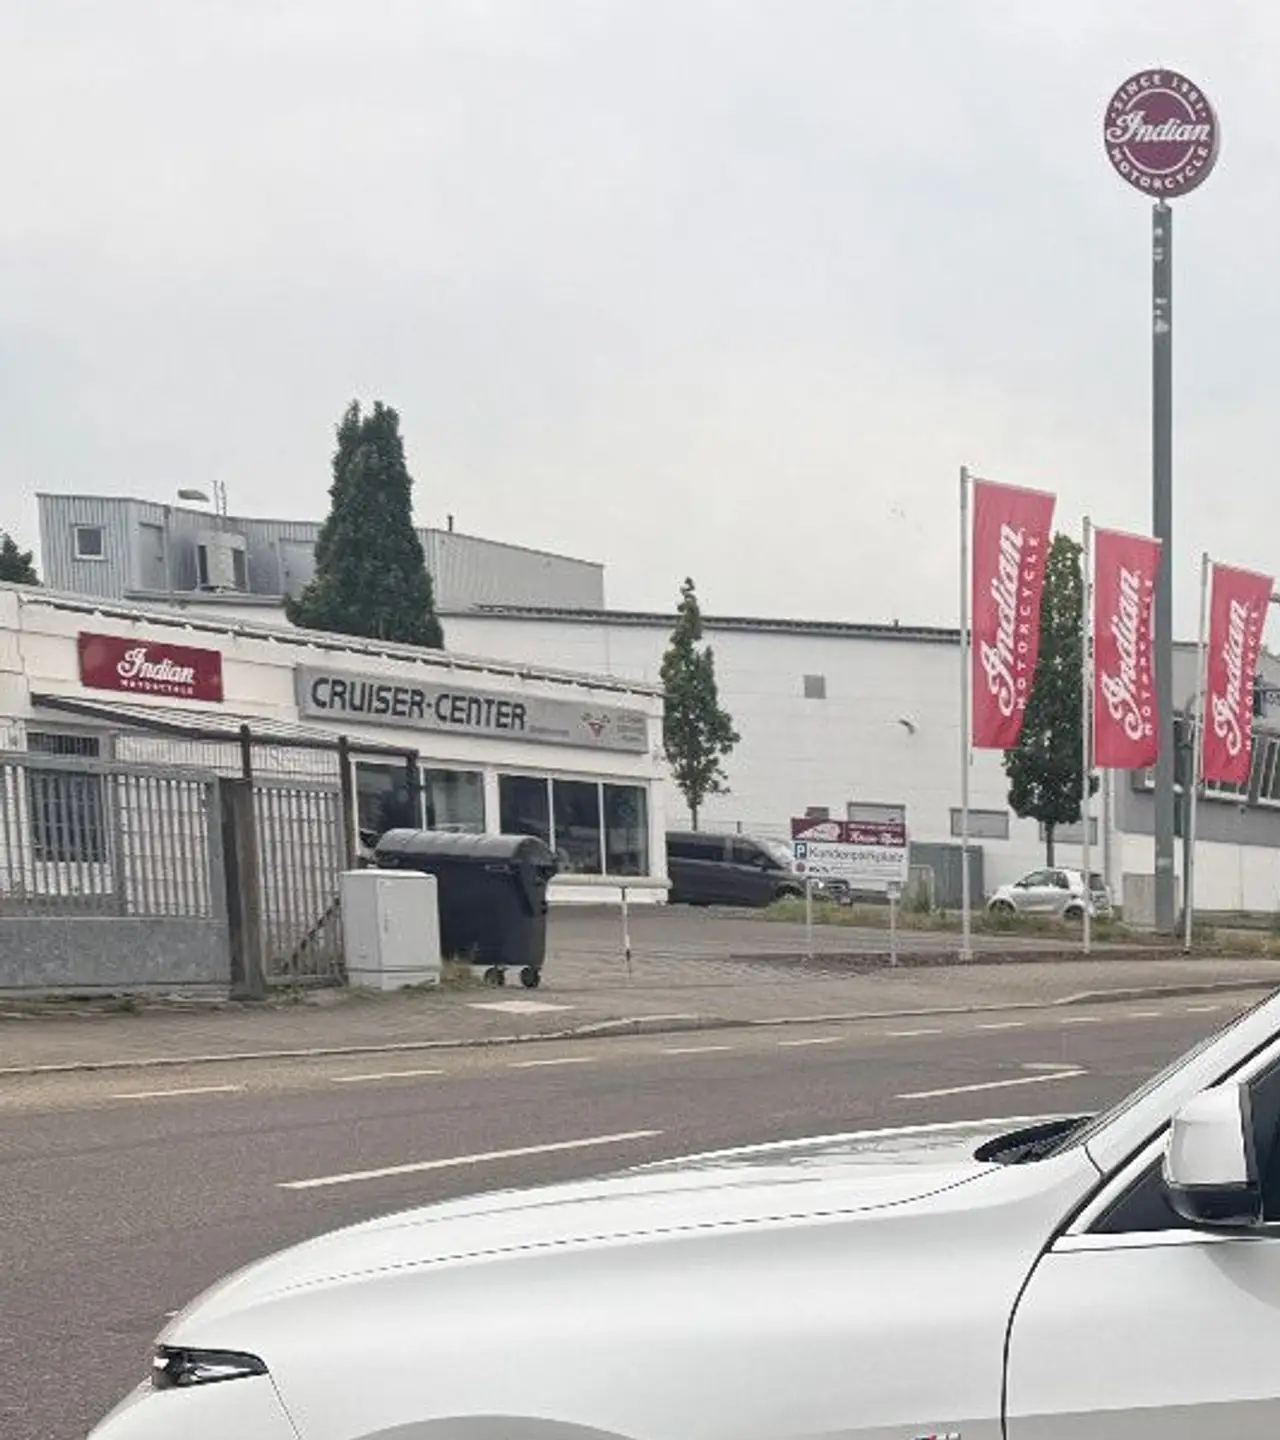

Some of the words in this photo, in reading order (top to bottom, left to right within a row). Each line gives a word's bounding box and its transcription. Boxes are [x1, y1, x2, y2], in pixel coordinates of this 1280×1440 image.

[1113, 74, 1163, 111] SINCE
[1106, 109, 1211, 144] Indian
[1110, 146, 1209, 190] MOTORCYCLE
[980, 523, 1024, 716] Indian
[1015, 535, 1040, 710] MOTORCYCLE
[117, 647, 194, 684] Indian
[1101, 567, 1141, 741] Indian
[1212, 600, 1249, 756] Indian
[311, 677, 527, 731] CRUISER-CENTER
